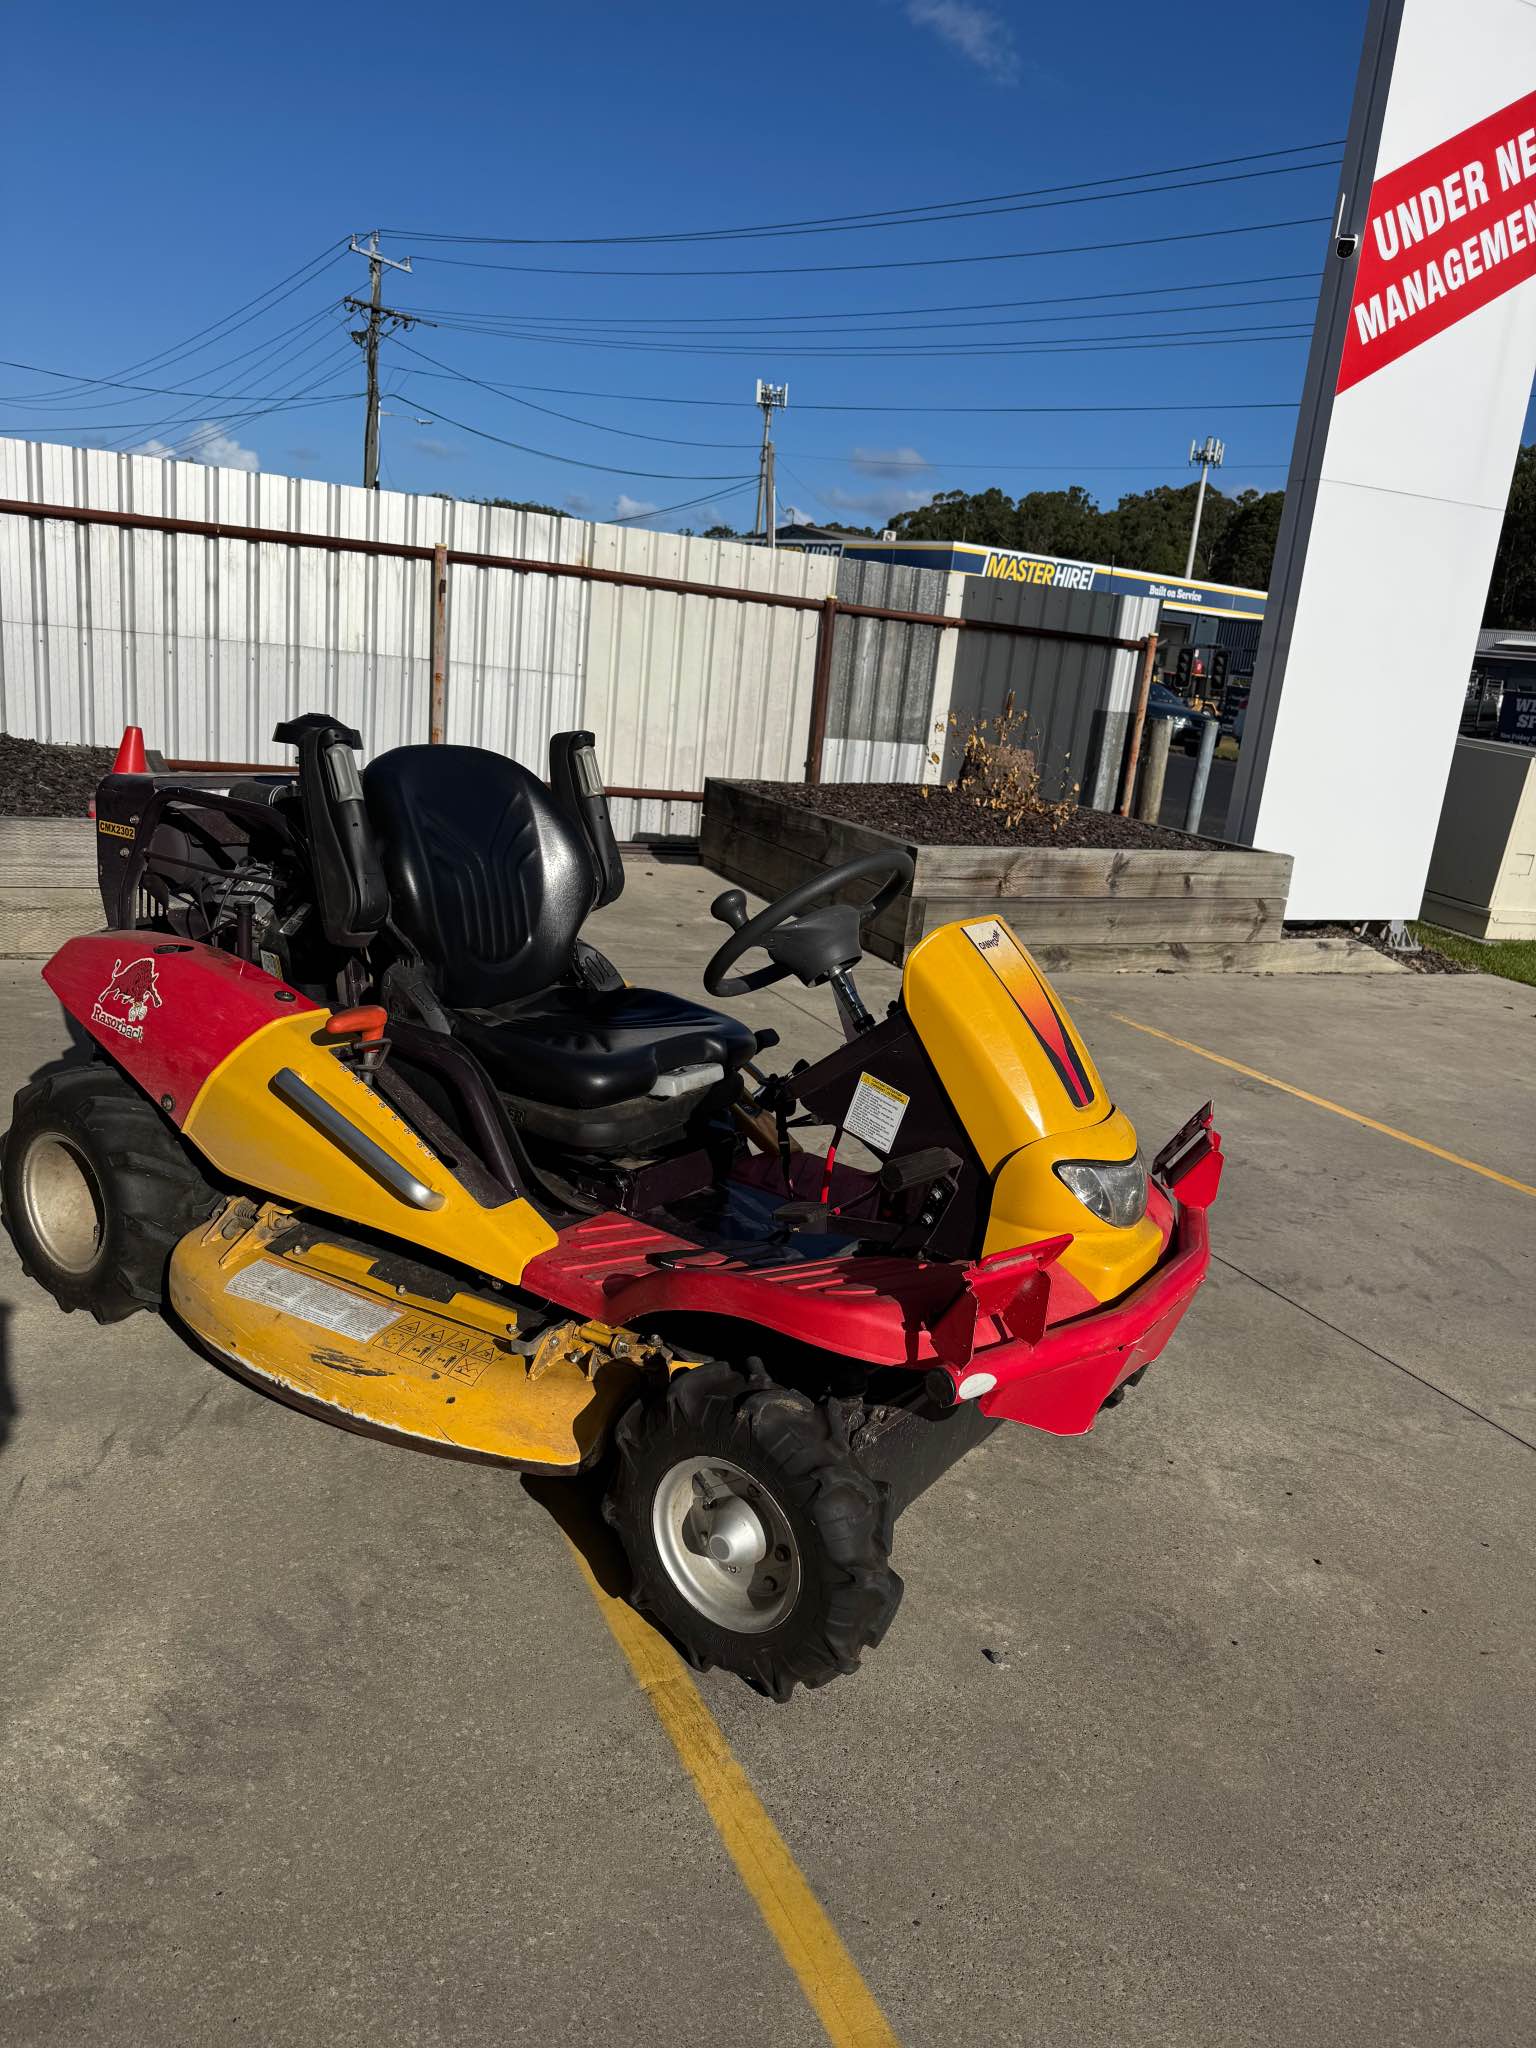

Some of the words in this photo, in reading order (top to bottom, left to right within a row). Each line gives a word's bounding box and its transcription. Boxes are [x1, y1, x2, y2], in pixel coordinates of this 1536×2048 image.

[1372, 160, 1490, 261] UNDER
[986, 554, 1091, 590] MASTERHIRE
[1149, 584, 1167, 597] Built
[1167, 589, 1177, 599] on
[1176, 588, 1203, 602] Service
[99, 821, 135, 839] CMX2302
